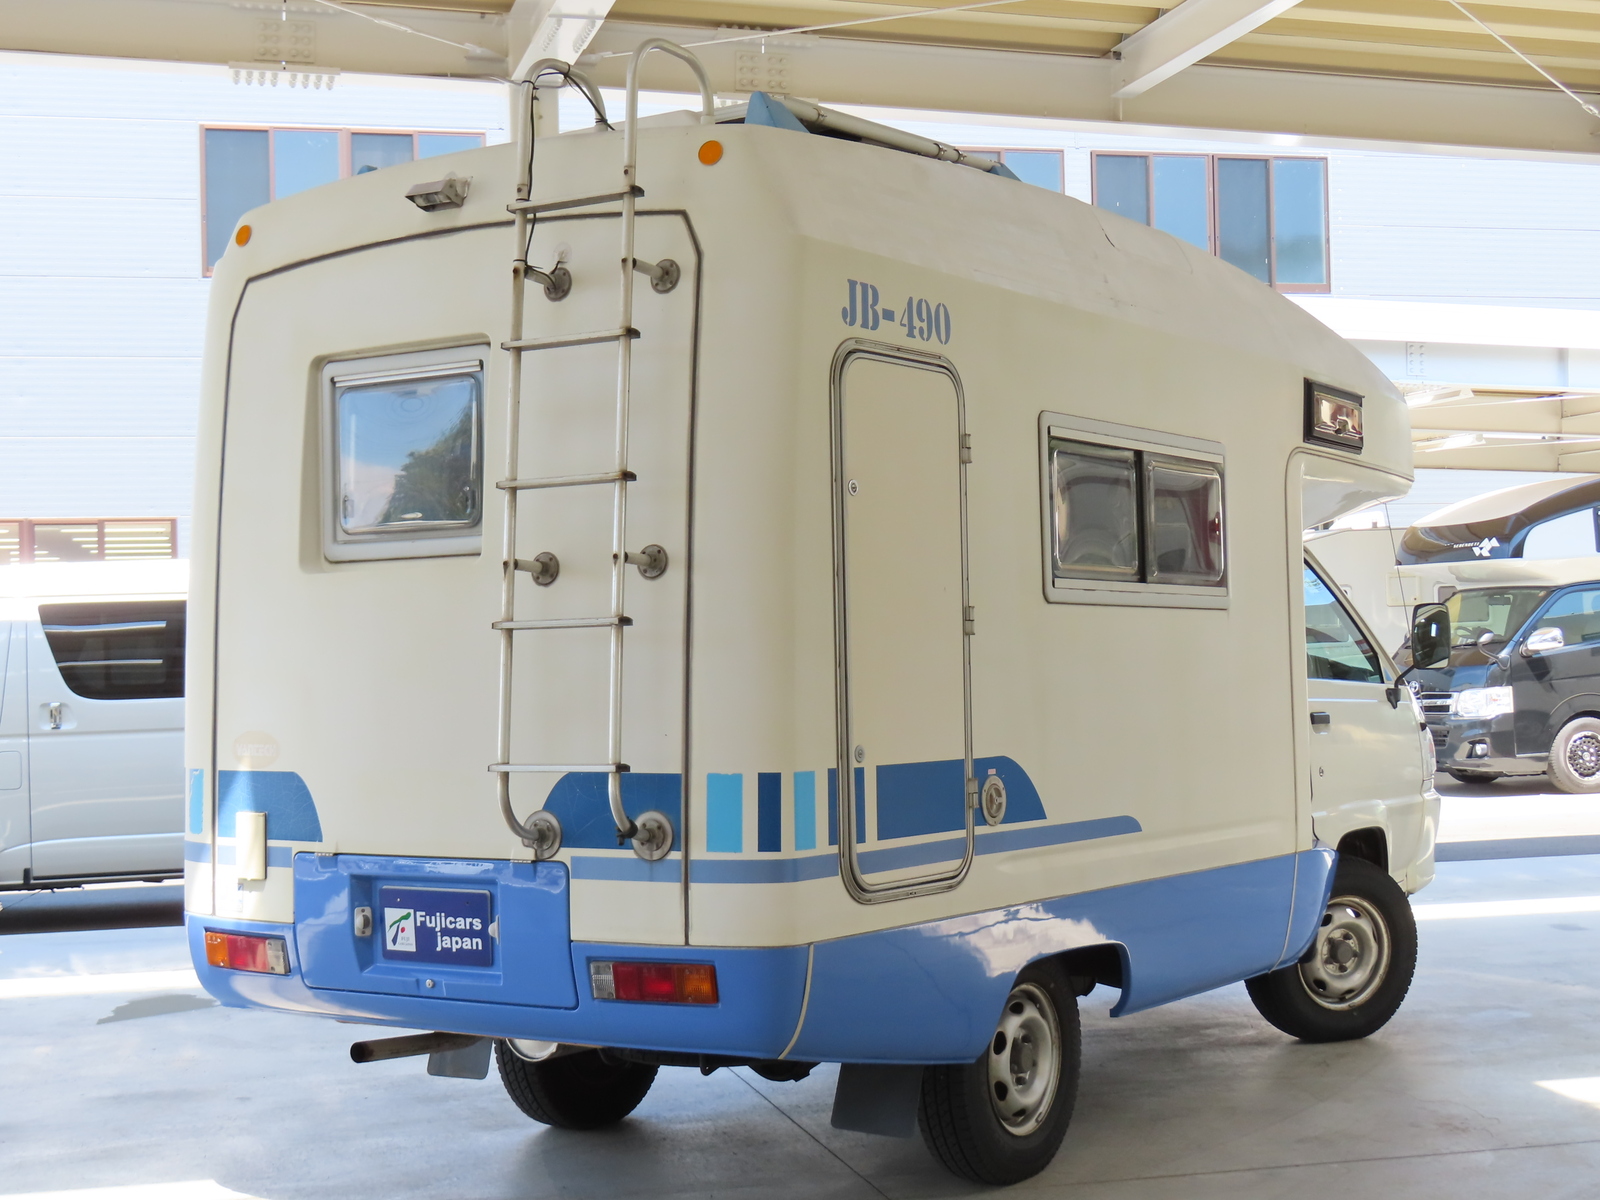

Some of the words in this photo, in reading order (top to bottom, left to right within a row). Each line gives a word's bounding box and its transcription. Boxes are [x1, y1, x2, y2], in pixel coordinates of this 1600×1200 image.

[841, 278, 951, 345] JB-490
[416, 911, 482, 932] Fujicars
[436, 931, 482, 952] japan
